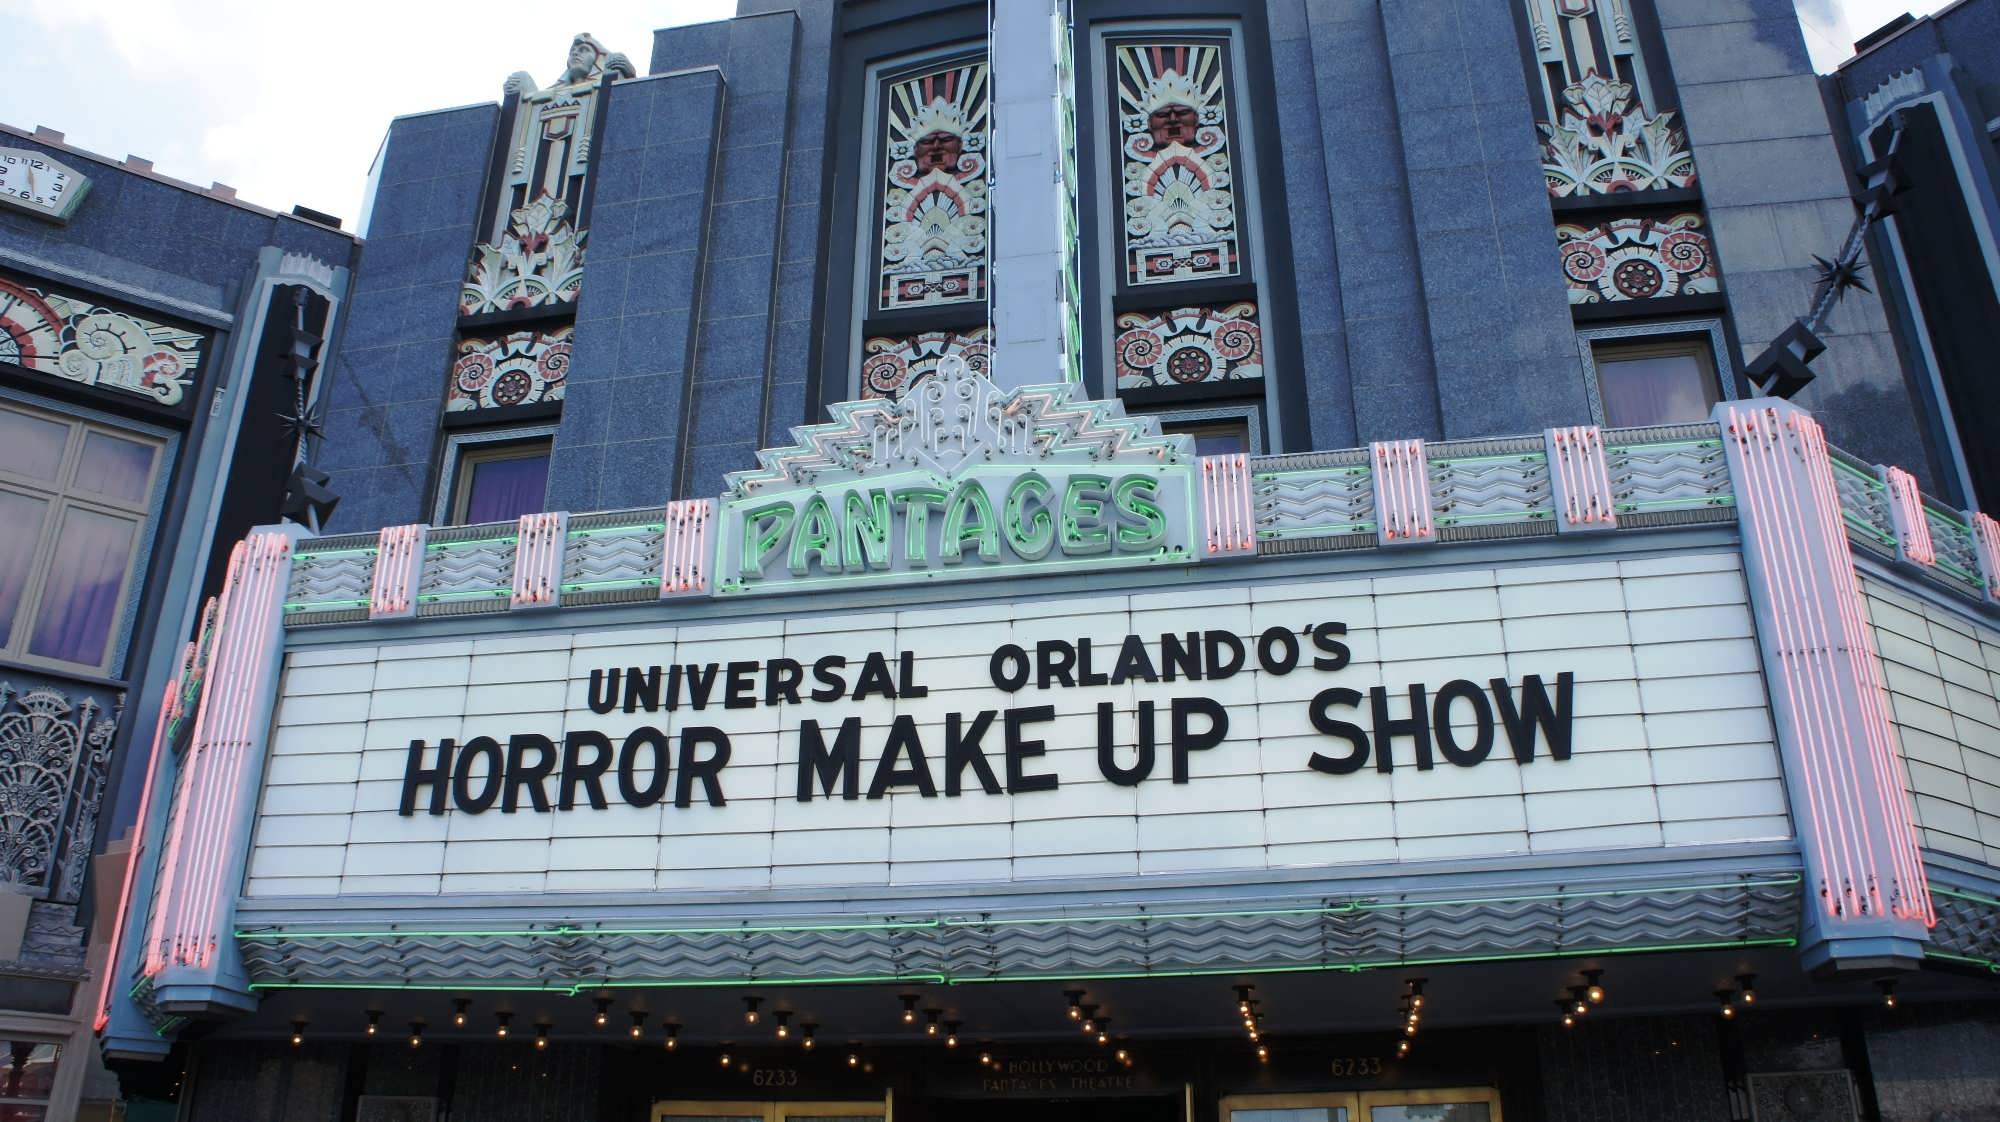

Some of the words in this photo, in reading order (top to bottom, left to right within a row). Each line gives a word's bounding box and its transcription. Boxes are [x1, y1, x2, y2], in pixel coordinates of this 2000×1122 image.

[4, 155, 16, 165] 10
[30, 159, 44, 170] 12
[20, 191, 30, 199] 6
[52, 183, 63, 192] 3
[35, 196, 44, 204] 5
[739, 472, 1168, 578] PANTAGES
[588, 651, 928, 714] UNIVERSAL
[990, 622, 1350, 693] ORLANDO'S
[399, 726, 731, 816] HORROR
[797, 705, 1059, 802] MAKE
[1097, 698, 1229, 788] UP
[1308, 672, 1575, 775] SHOW
[1008, 1058, 1107, 1074] HOLLYWOOD
[1331, 1057, 1382, 1076] 6233
[753, 1070, 798, 1086] 6233
